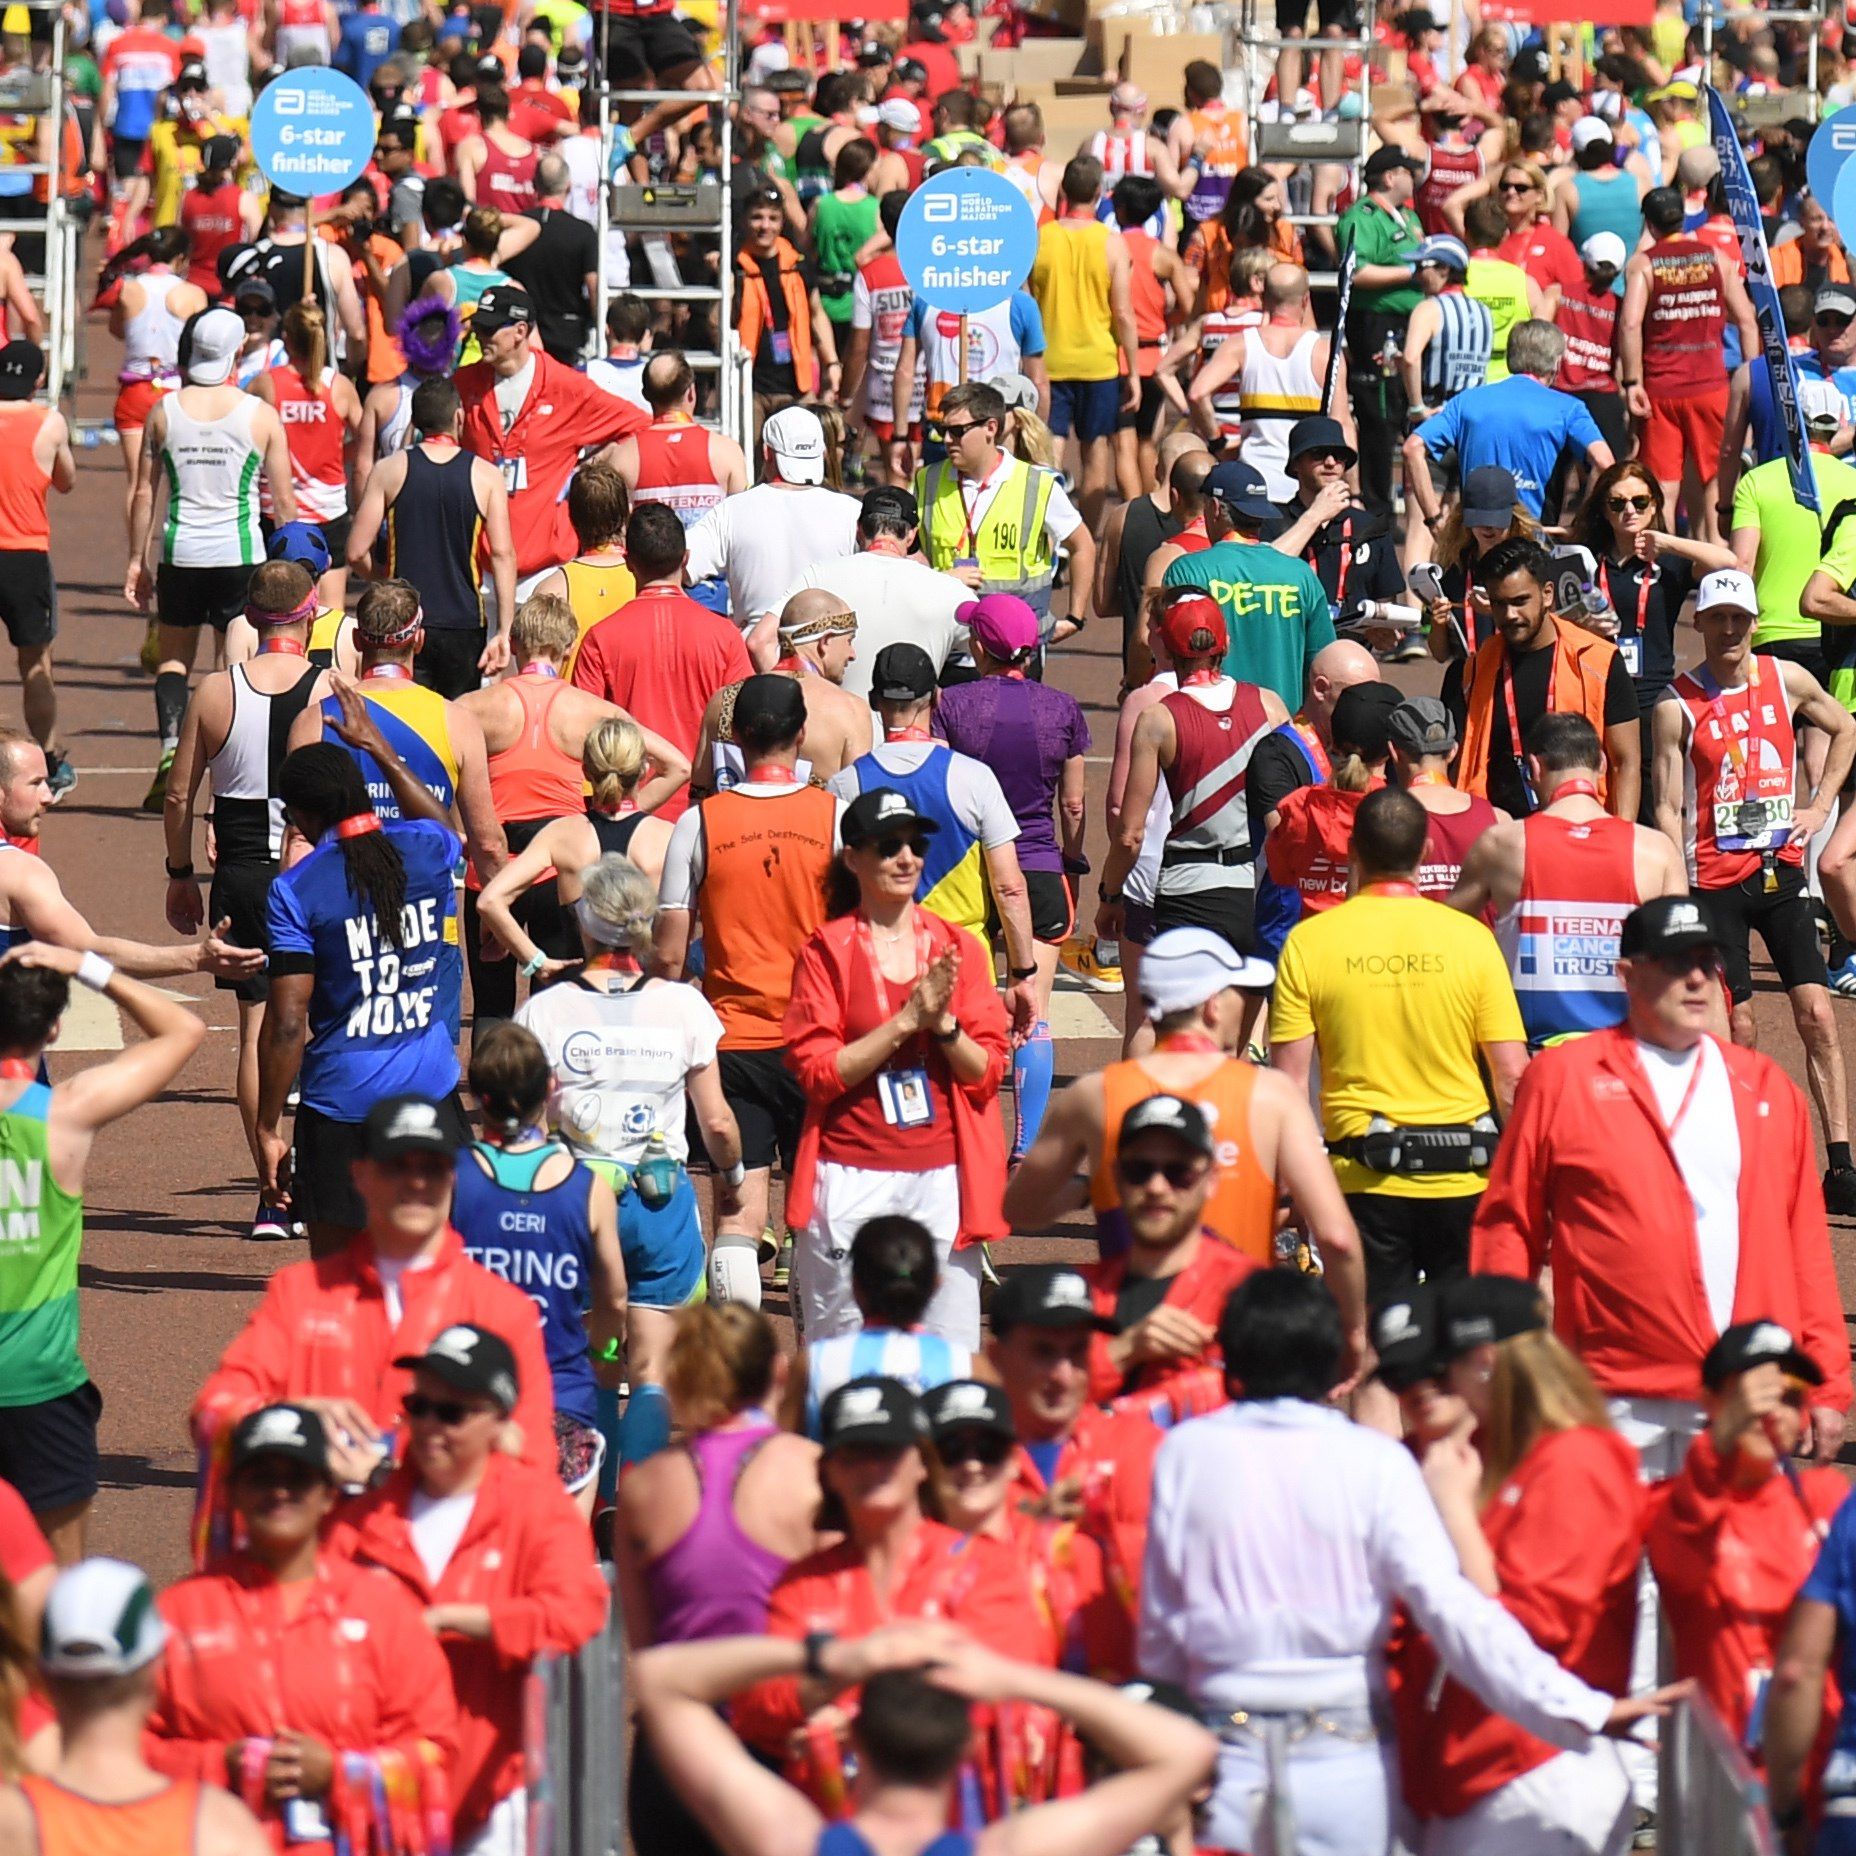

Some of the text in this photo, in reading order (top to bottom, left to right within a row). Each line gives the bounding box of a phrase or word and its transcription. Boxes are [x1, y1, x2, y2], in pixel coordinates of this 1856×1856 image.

[280, 124, 346, 146] 6-star
[271, 151, 353, 175] finisher
[931, 234, 1003, 256] 6-star
[922, 265, 1012, 288] finisher
[992, 523, 1019, 550] 190
[1715, 577, 1741, 593] NY
[1208, 579, 1302, 619] PETE
[1758, 777, 1788, 790] oney
[714, 829, 825, 855] The Sole Destroyers
[1298, 876, 1327, 892] new
[1554, 918, 1624, 936] TEENA
[1554, 937, 1621, 955] CANC
[351, 953, 401, 995] TO
[1346, 954, 1445, 975] MOORES
[1554, 956, 1620, 976] TRUST
[569, 1046, 674, 1060] Child Brain Injury
[499, 1210, 547, 1238] CERI
